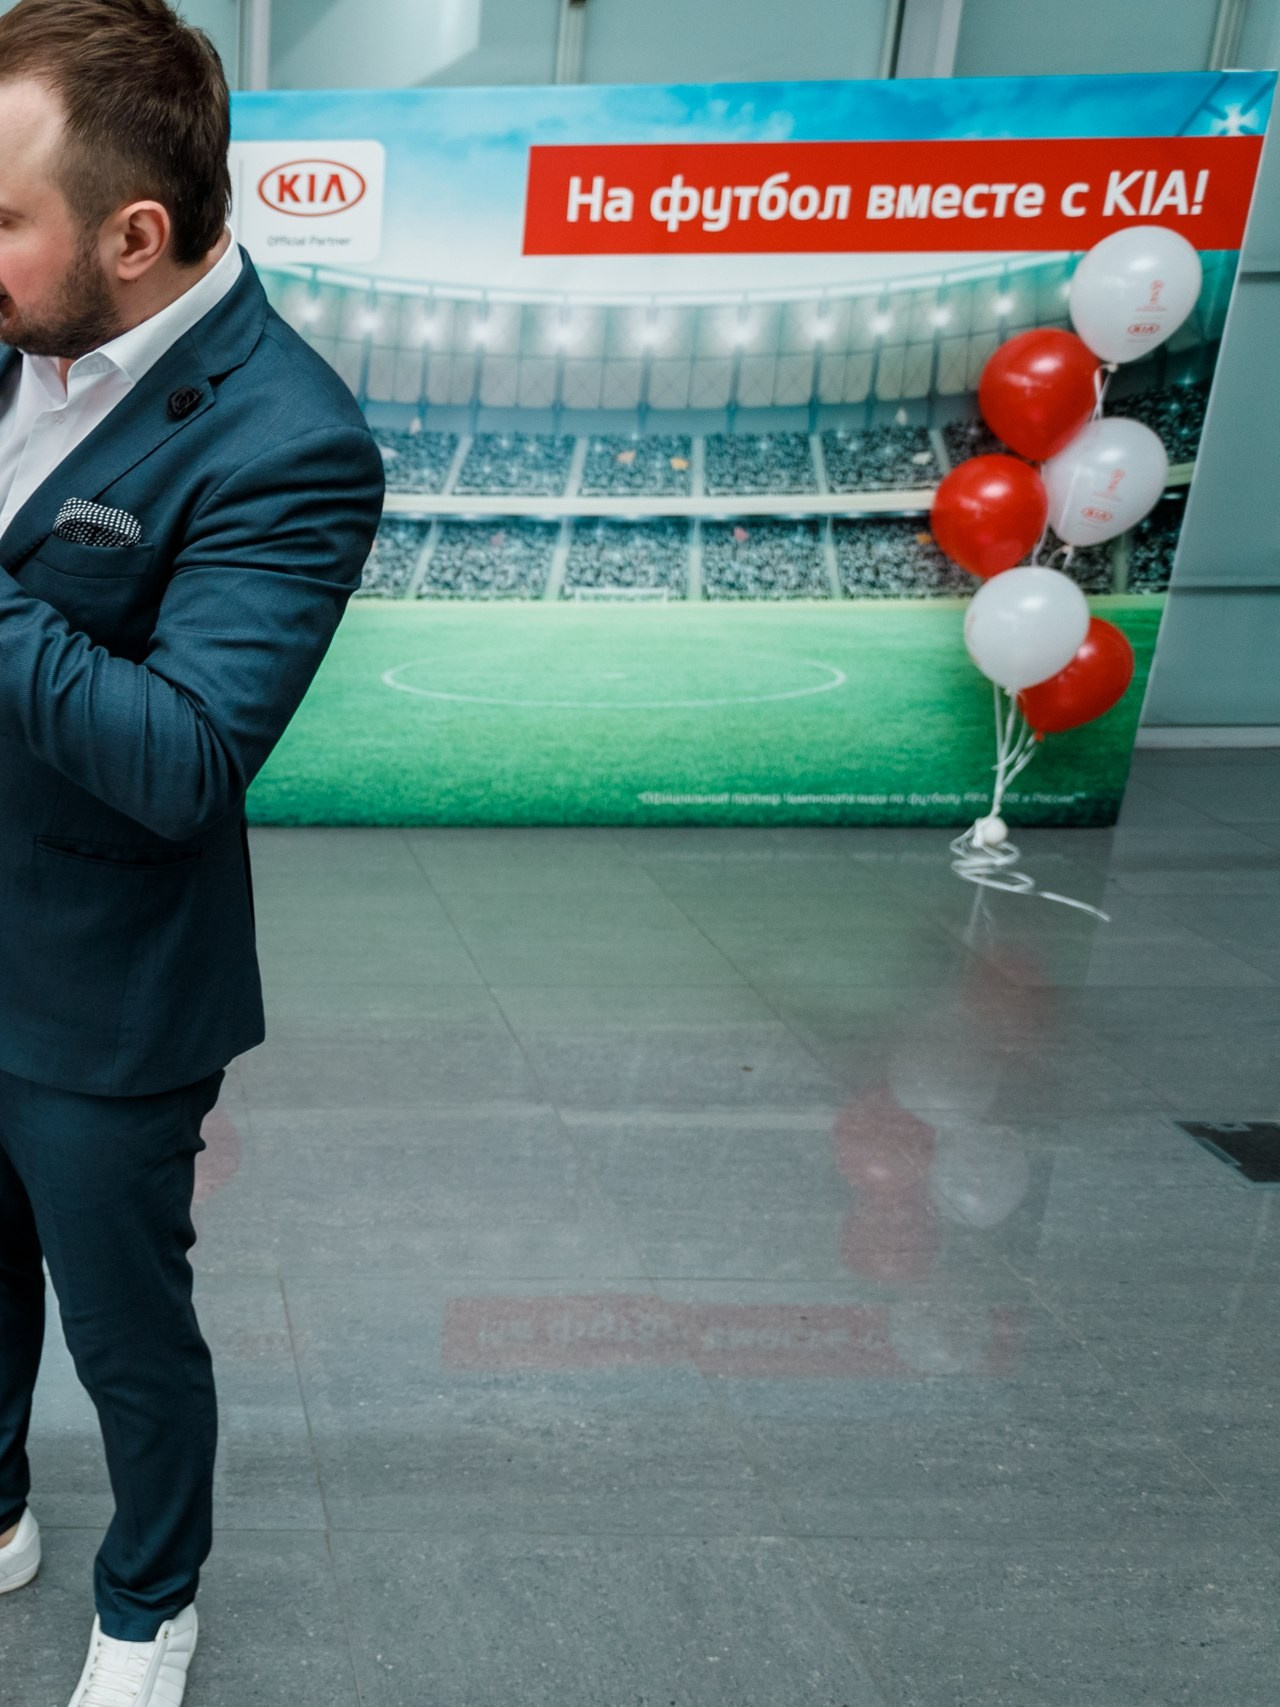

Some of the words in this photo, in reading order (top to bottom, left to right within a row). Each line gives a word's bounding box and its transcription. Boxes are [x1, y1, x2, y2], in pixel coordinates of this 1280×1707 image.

[277, 173, 346, 203] KIA
[566, 176, 635, 223] На
[649, 171, 851, 233] футбол
[866, 182, 1045, 220] вместе
[1060, 182, 1089, 218] с
[1102, 169, 1209, 217] KIA!
[267, 235, 306, 246] Official
[309, 235, 352, 246] Partner
